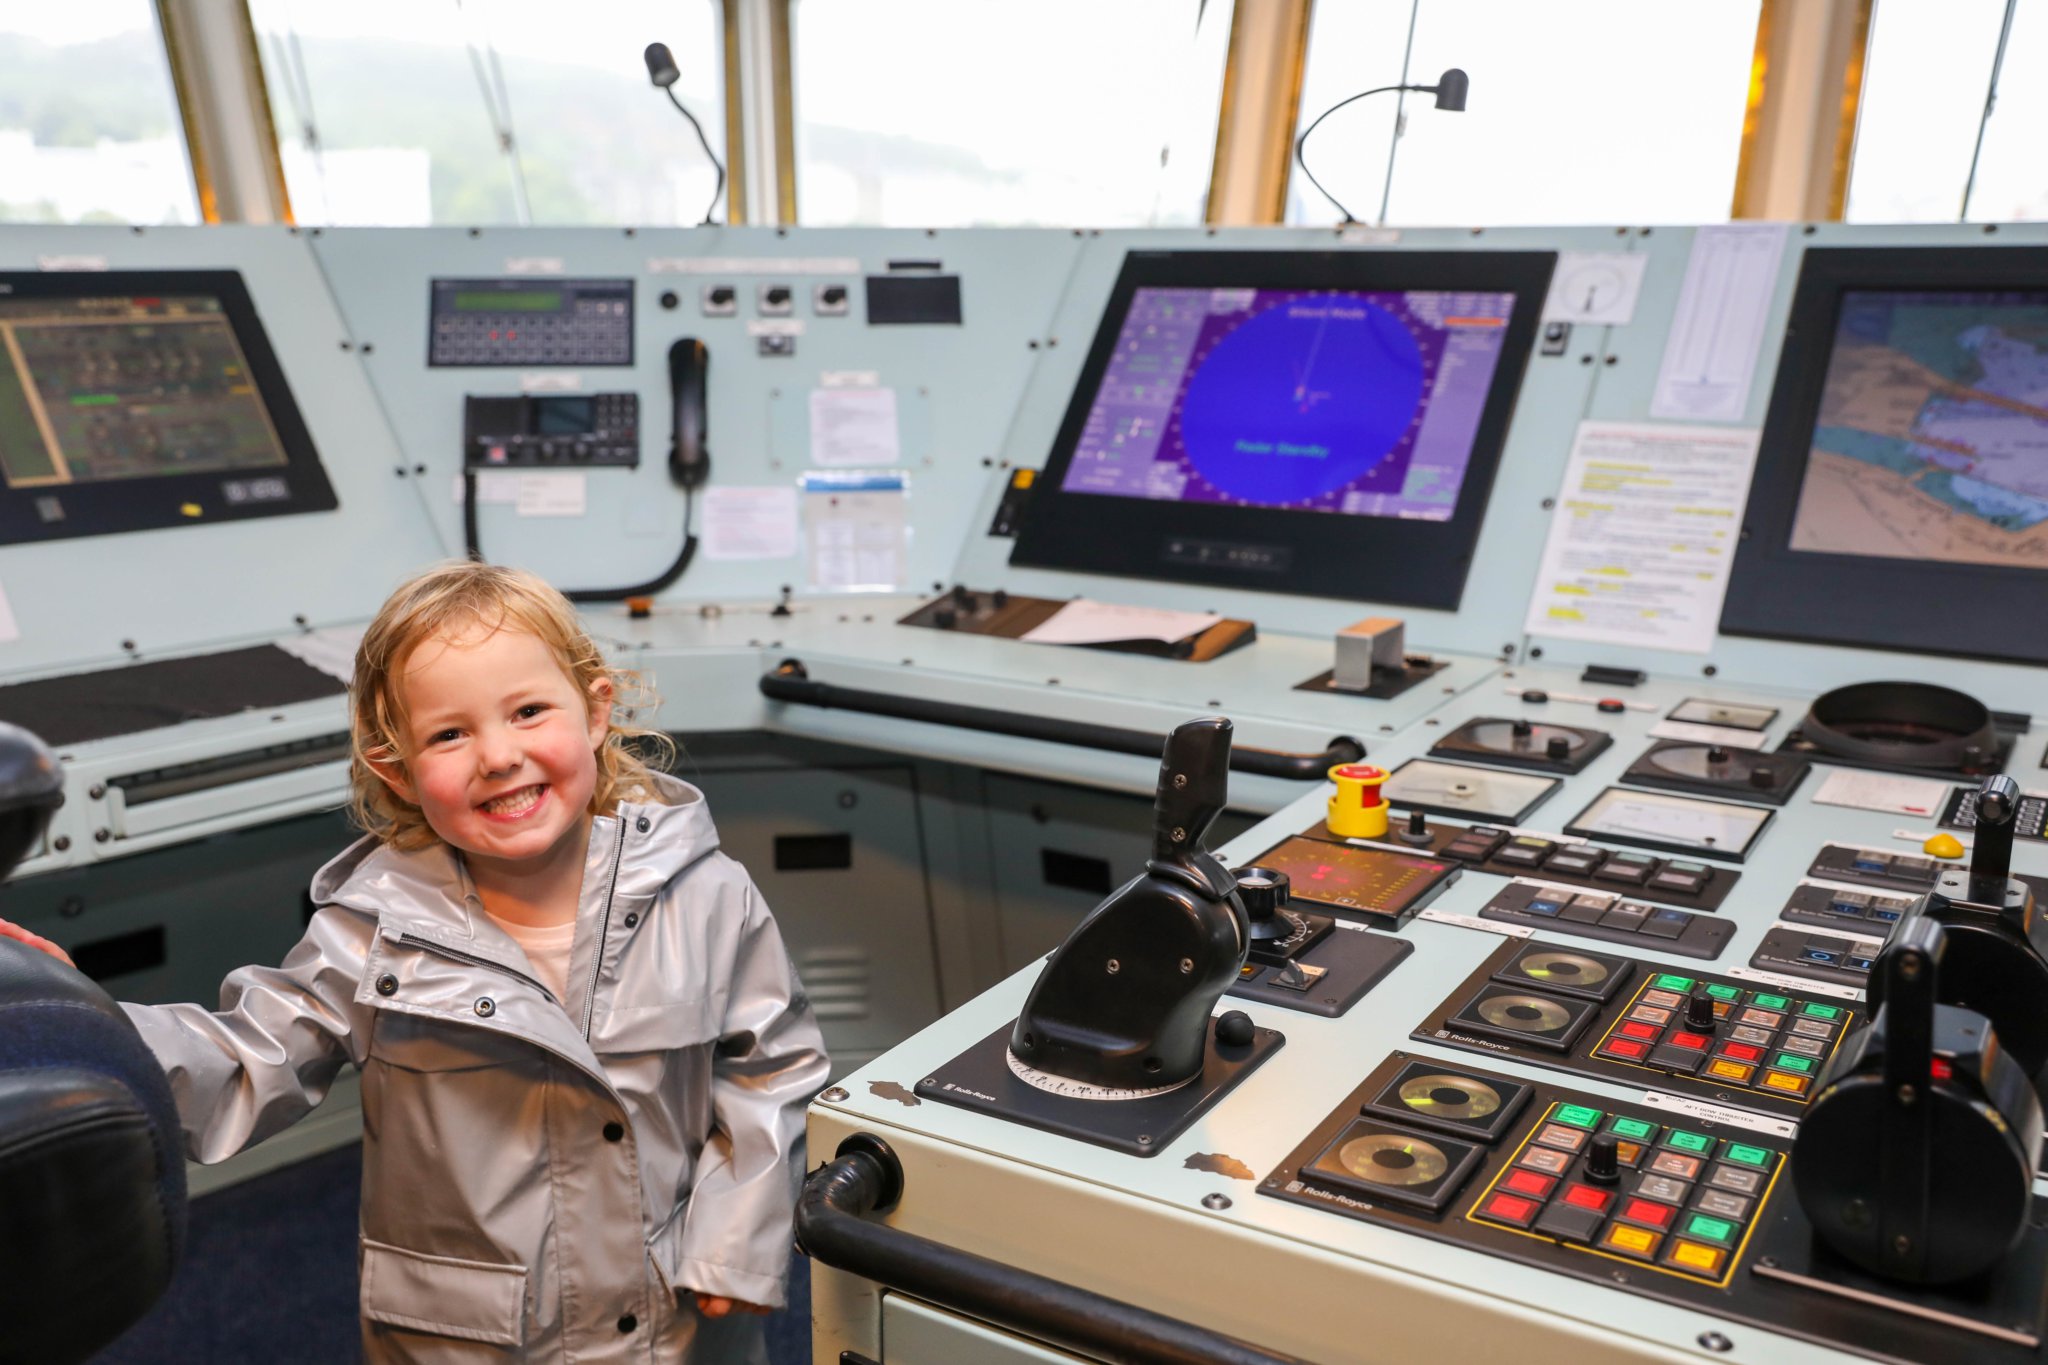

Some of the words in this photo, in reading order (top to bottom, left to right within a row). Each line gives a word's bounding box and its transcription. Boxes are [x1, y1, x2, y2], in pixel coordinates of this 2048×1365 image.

[1451, 1034, 1510, 1051] Rolls-Royce
[954, 1086, 996, 1101] Rolls-Royce
[1304, 1187, 1373, 1210] Rolls-Royce
